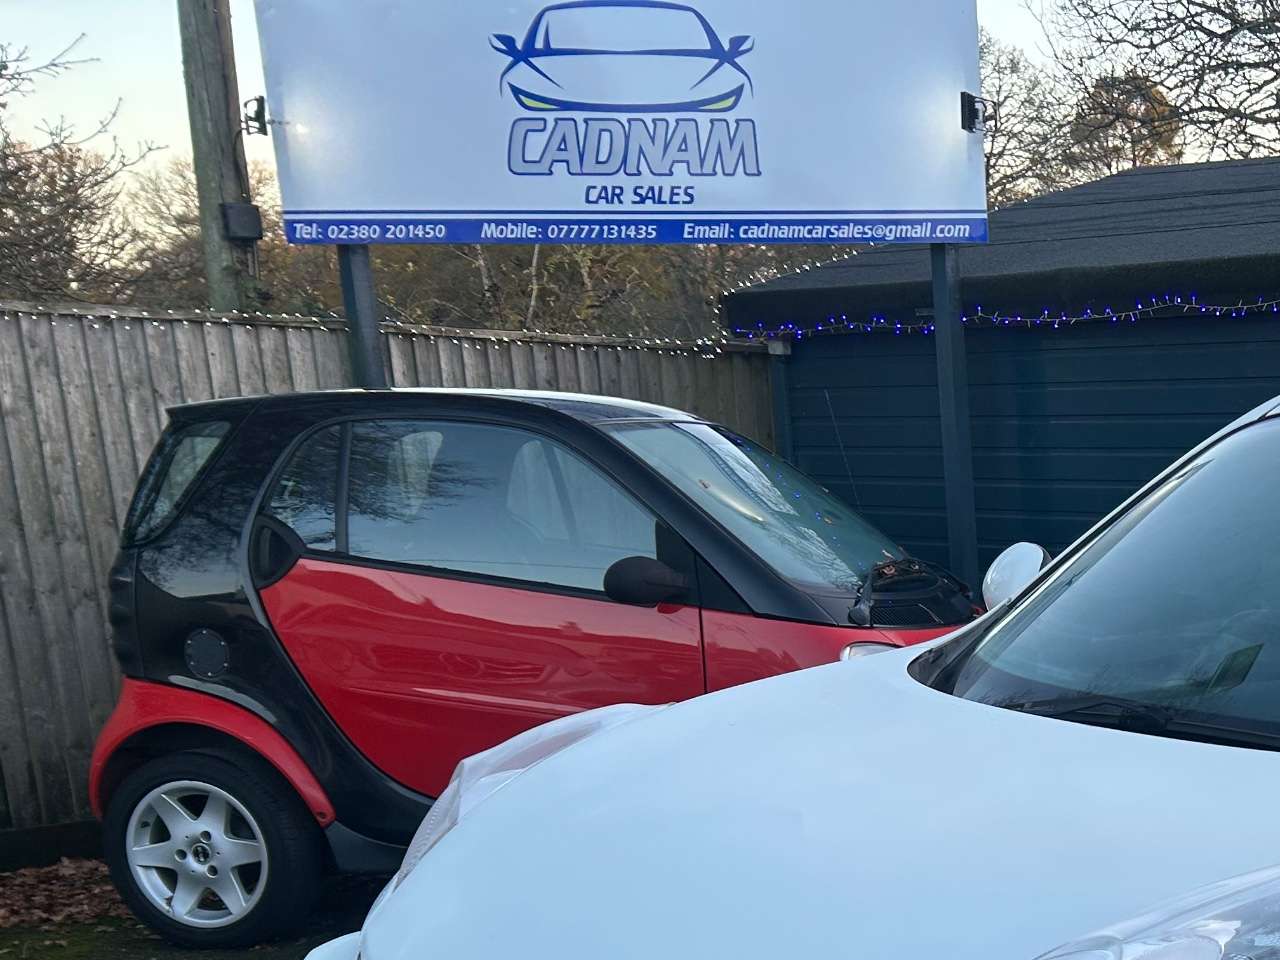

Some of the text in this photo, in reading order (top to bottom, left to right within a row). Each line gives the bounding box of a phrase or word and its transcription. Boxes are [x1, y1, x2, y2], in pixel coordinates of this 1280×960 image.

[508, 117, 762, 176] CADNAM
[585, 185, 695, 205] CAR SALES
[293, 222, 322, 239] Tel:
[327, 224, 380, 239] 02380
[385, 224, 446, 239] 201450
[481, 222, 542, 239] Mobile:
[547, 224, 657, 239] 07777131435
[683, 222, 734, 239] Email:
